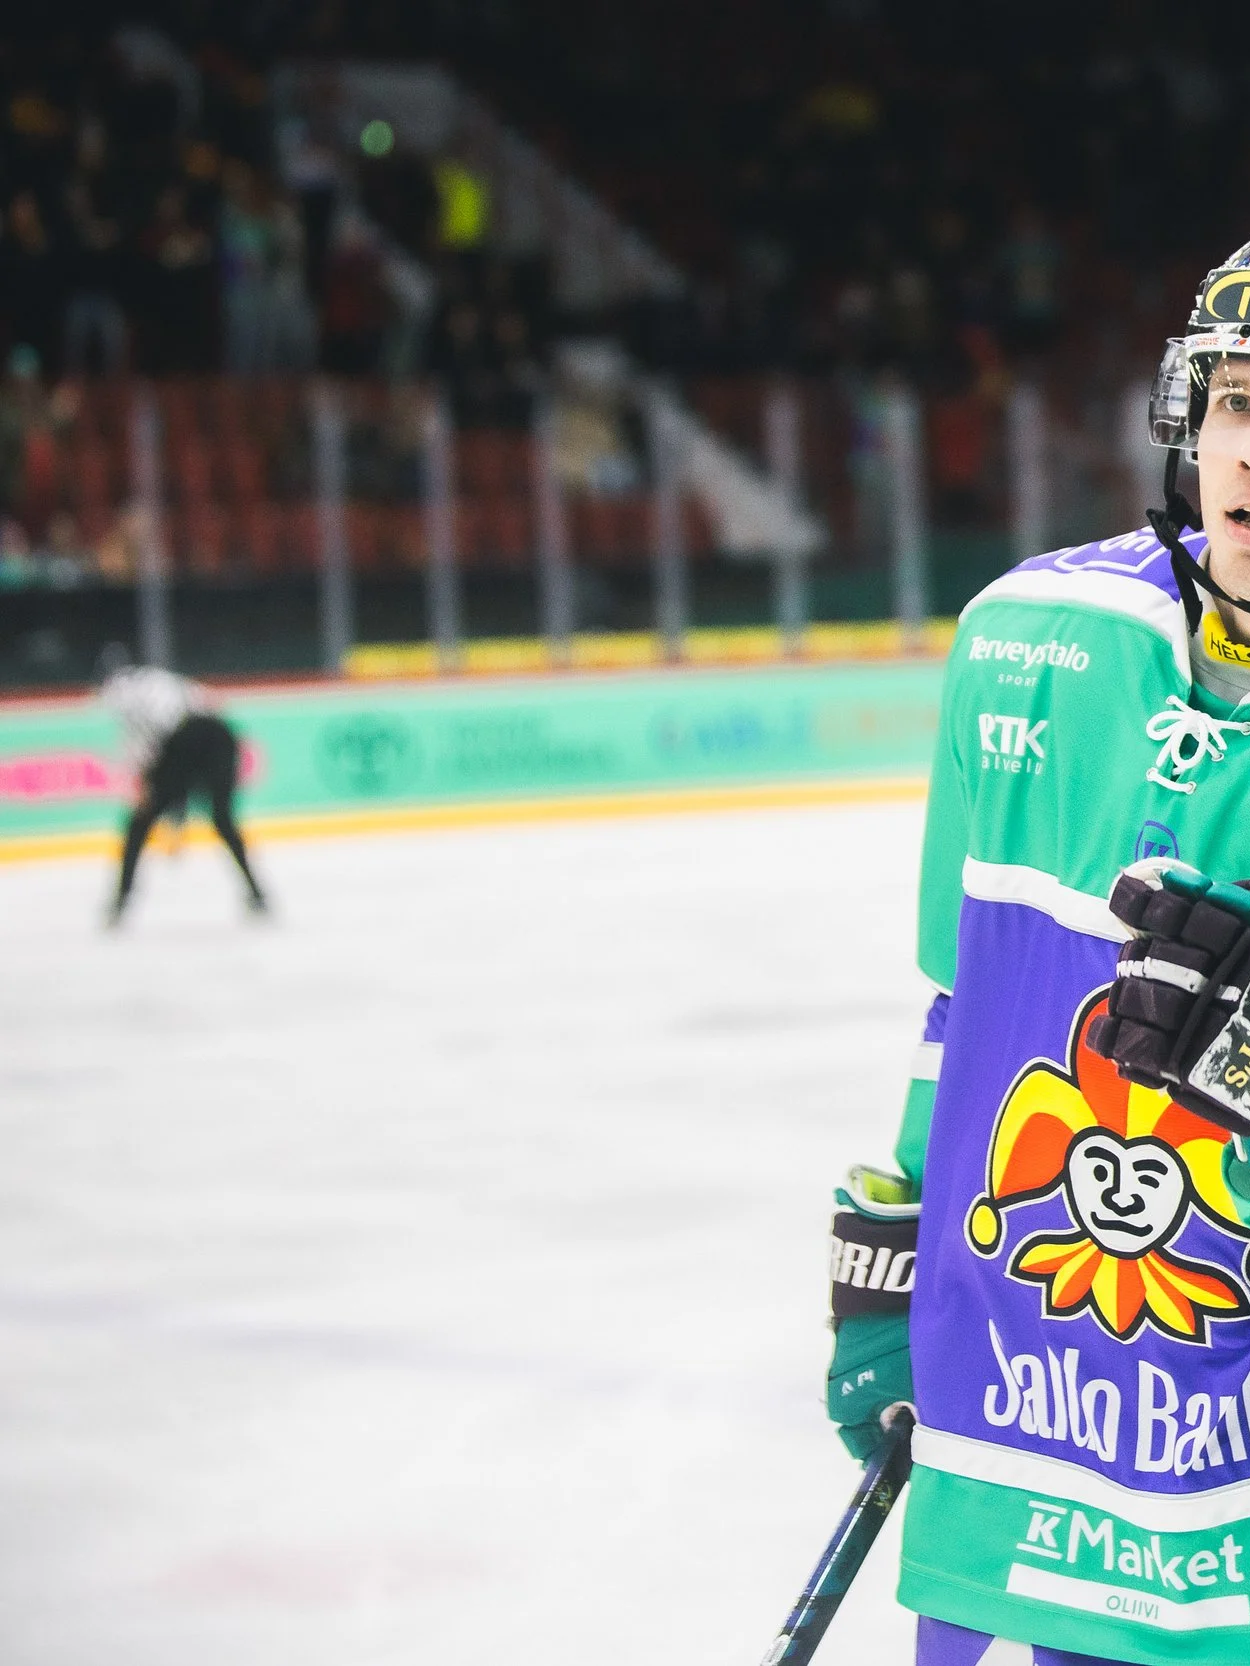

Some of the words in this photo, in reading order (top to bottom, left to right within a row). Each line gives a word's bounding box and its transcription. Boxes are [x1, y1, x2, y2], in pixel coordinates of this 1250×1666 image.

[968, 635, 1090, 672] Terveystalo
[997, 673, 1039, 687] SPORT
[978, 713, 1049, 759] RTK
[1066, 1509, 1245, 1591] Market
[1105, 1594, 1160, 1620] OLIIVI
